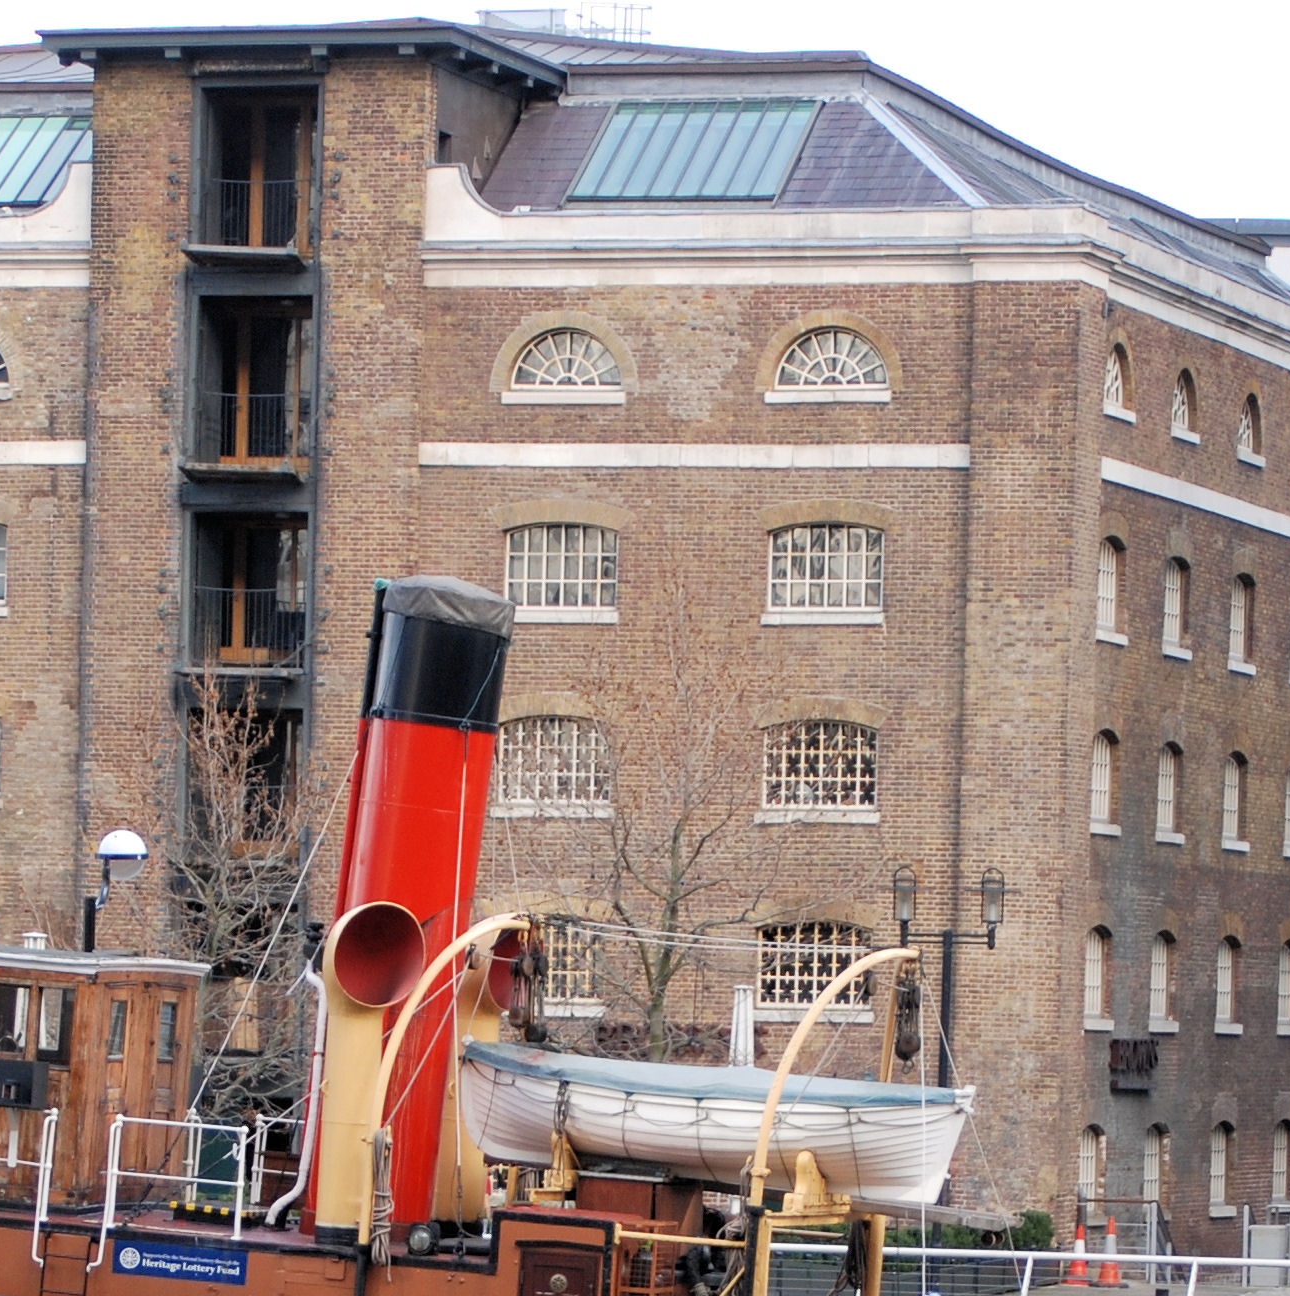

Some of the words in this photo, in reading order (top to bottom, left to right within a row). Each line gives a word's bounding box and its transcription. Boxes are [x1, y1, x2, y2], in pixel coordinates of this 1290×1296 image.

[142, 1259, 181, 1273] Heritage
[182, 1262, 216, 1276] Lottery
[217, 1265, 240, 1276] Fund
